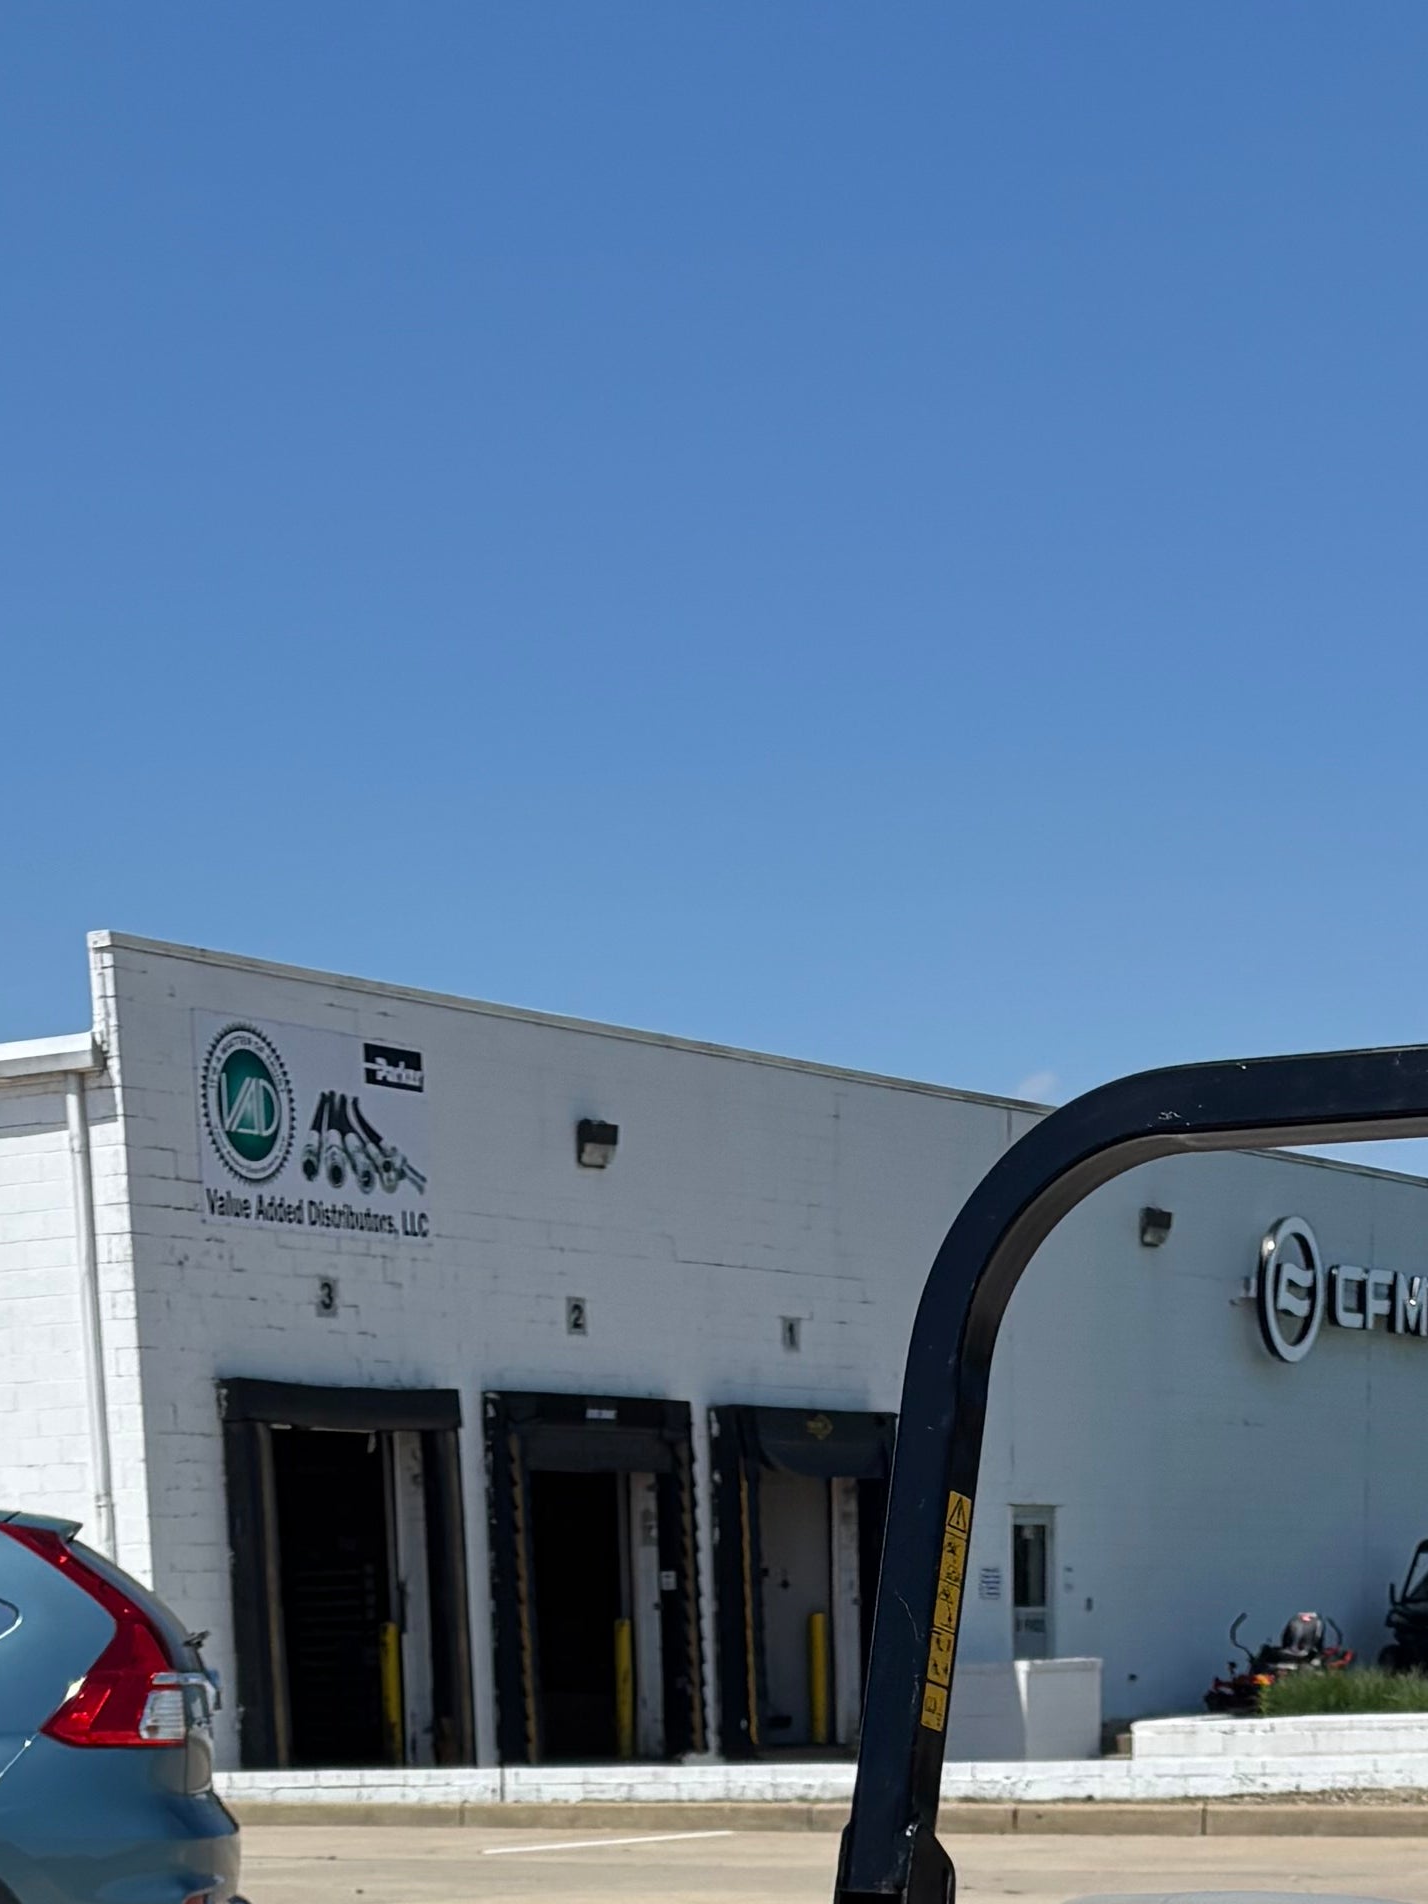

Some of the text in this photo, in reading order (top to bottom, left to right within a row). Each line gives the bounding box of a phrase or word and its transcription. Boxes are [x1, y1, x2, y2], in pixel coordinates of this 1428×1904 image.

[205, 1187, 431, 1238] Value Added Distributors, LLC
[319, 1281, 334, 1310] 3
[571, 1302, 585, 1331] 2
